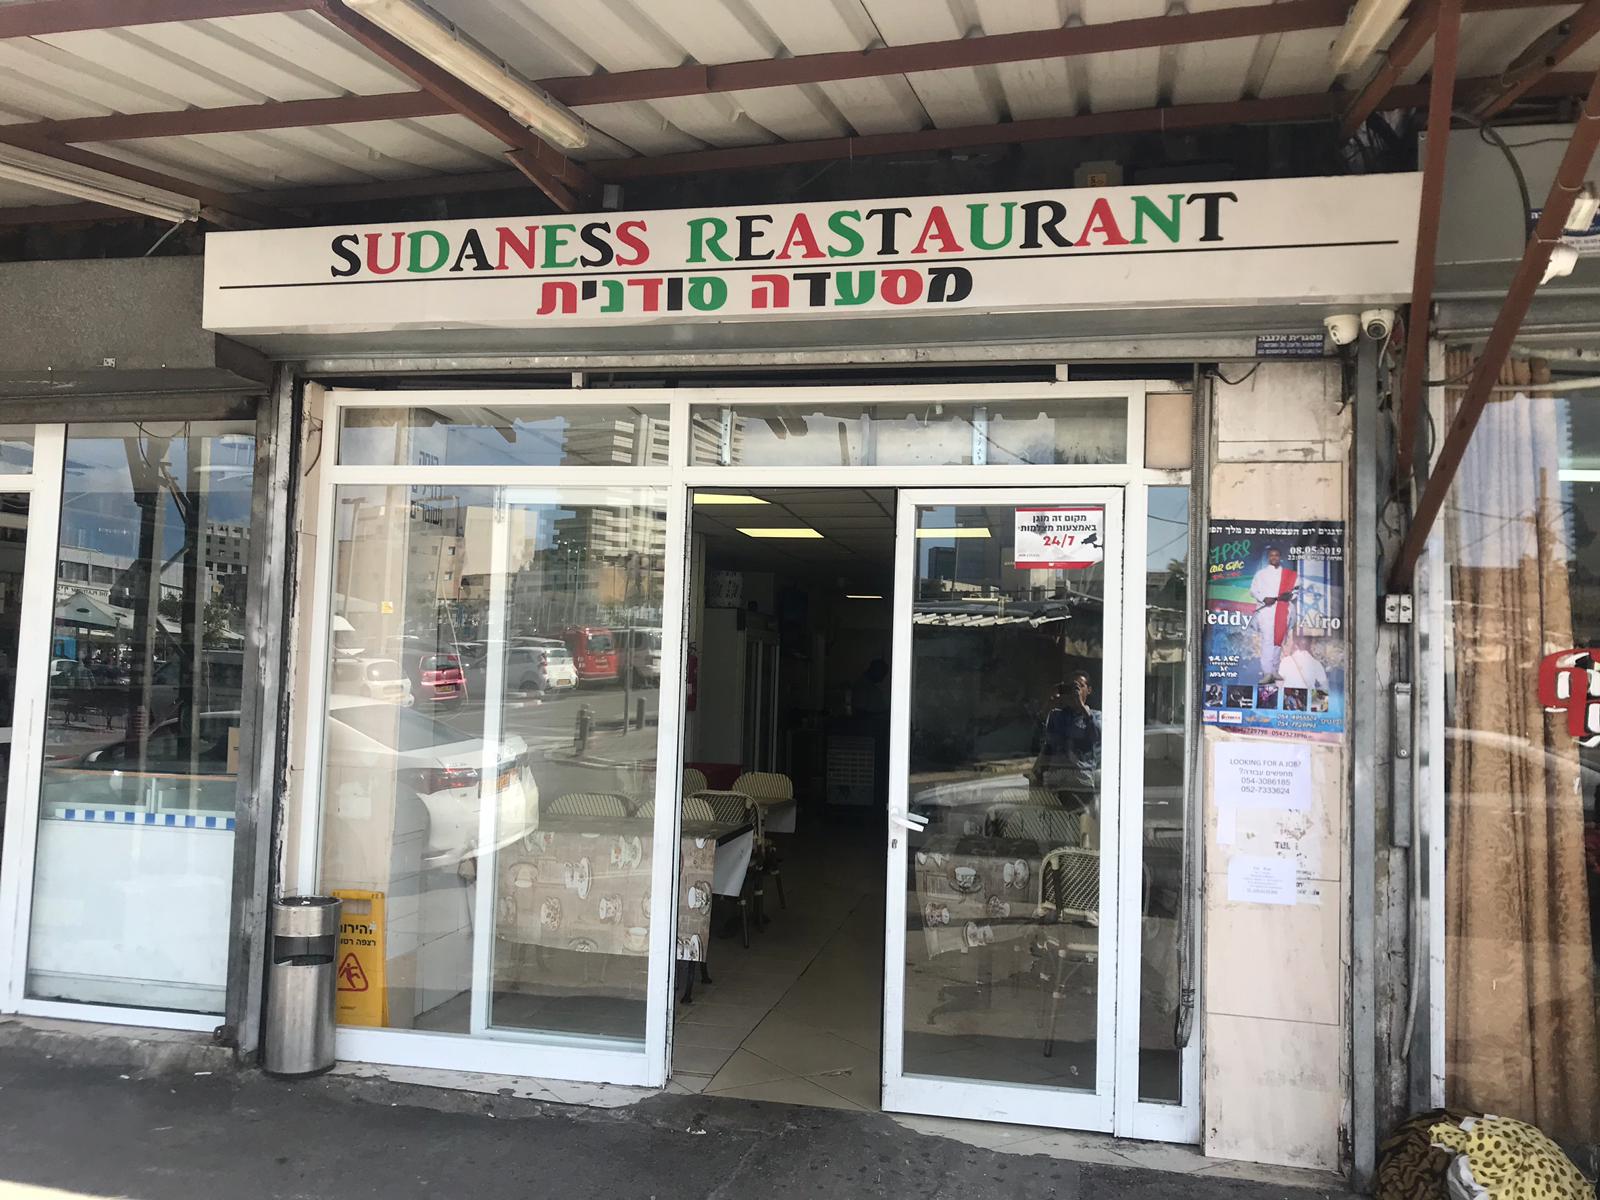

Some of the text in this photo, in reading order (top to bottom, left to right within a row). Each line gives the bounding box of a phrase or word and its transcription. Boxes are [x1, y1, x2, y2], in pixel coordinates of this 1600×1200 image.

[331, 191, 1238, 277] SUDANESS REASTAURANT
[536, 266, 973, 316] מסעדה סודנית
[1032, 515, 1050, 523] מוגן
[1056, 524, 1097, 532] באמצעות
[1225, 525, 1242, 535] מלך
[1244, 527, 1257, 535] עם
[1259, 527, 1300, 536] העצמאות
[1302, 528, 1316, 536] יום
[1043, 533, 1075, 548] 24/7
[1289, 546, 1342, 556] 08.05.2019
[1204, 610, 1341, 630] Teddy Afro
[1230, 758, 1261, 766] LOOKING
[1265, 769, 1293, 777] מחפשים
[1241, 777, 1291, 786] 054-3086185
[1240, 785, 1290, 795] 052-7333624
[355, 938, 377, 947] רצפה
